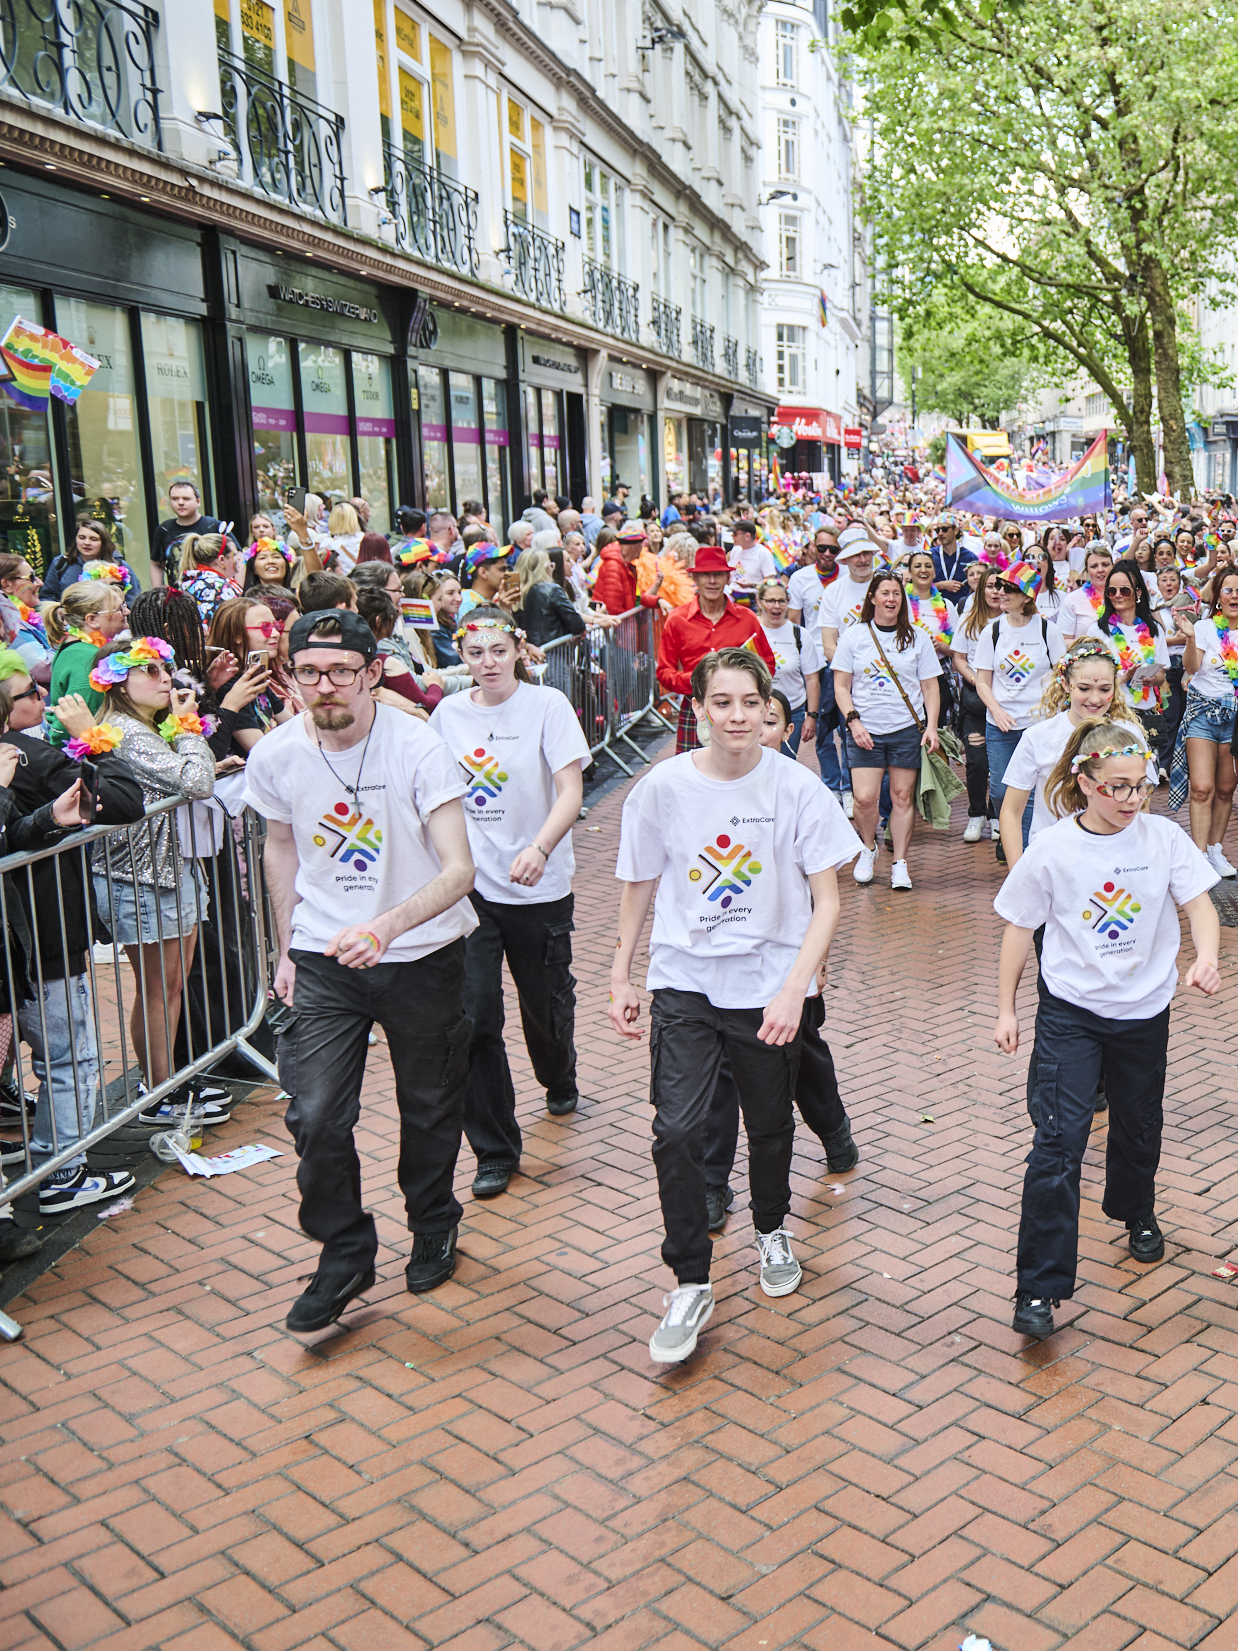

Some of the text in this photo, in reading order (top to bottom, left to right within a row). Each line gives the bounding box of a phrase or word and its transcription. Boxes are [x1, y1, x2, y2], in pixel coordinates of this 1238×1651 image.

[279, 285, 320, 309] WATCHES
[157, 362, 189, 379] ROLEX
[251, 371, 275, 386] OMEGA
[311, 380, 331, 393] OMEGA
[362, 389, 380, 401] TUDOR
[699, 914, 721, 923] Pride
[728, 906, 752, 914] every
[1118, 938, 1137, 946] every
[1100, 946, 1134, 958] generation
